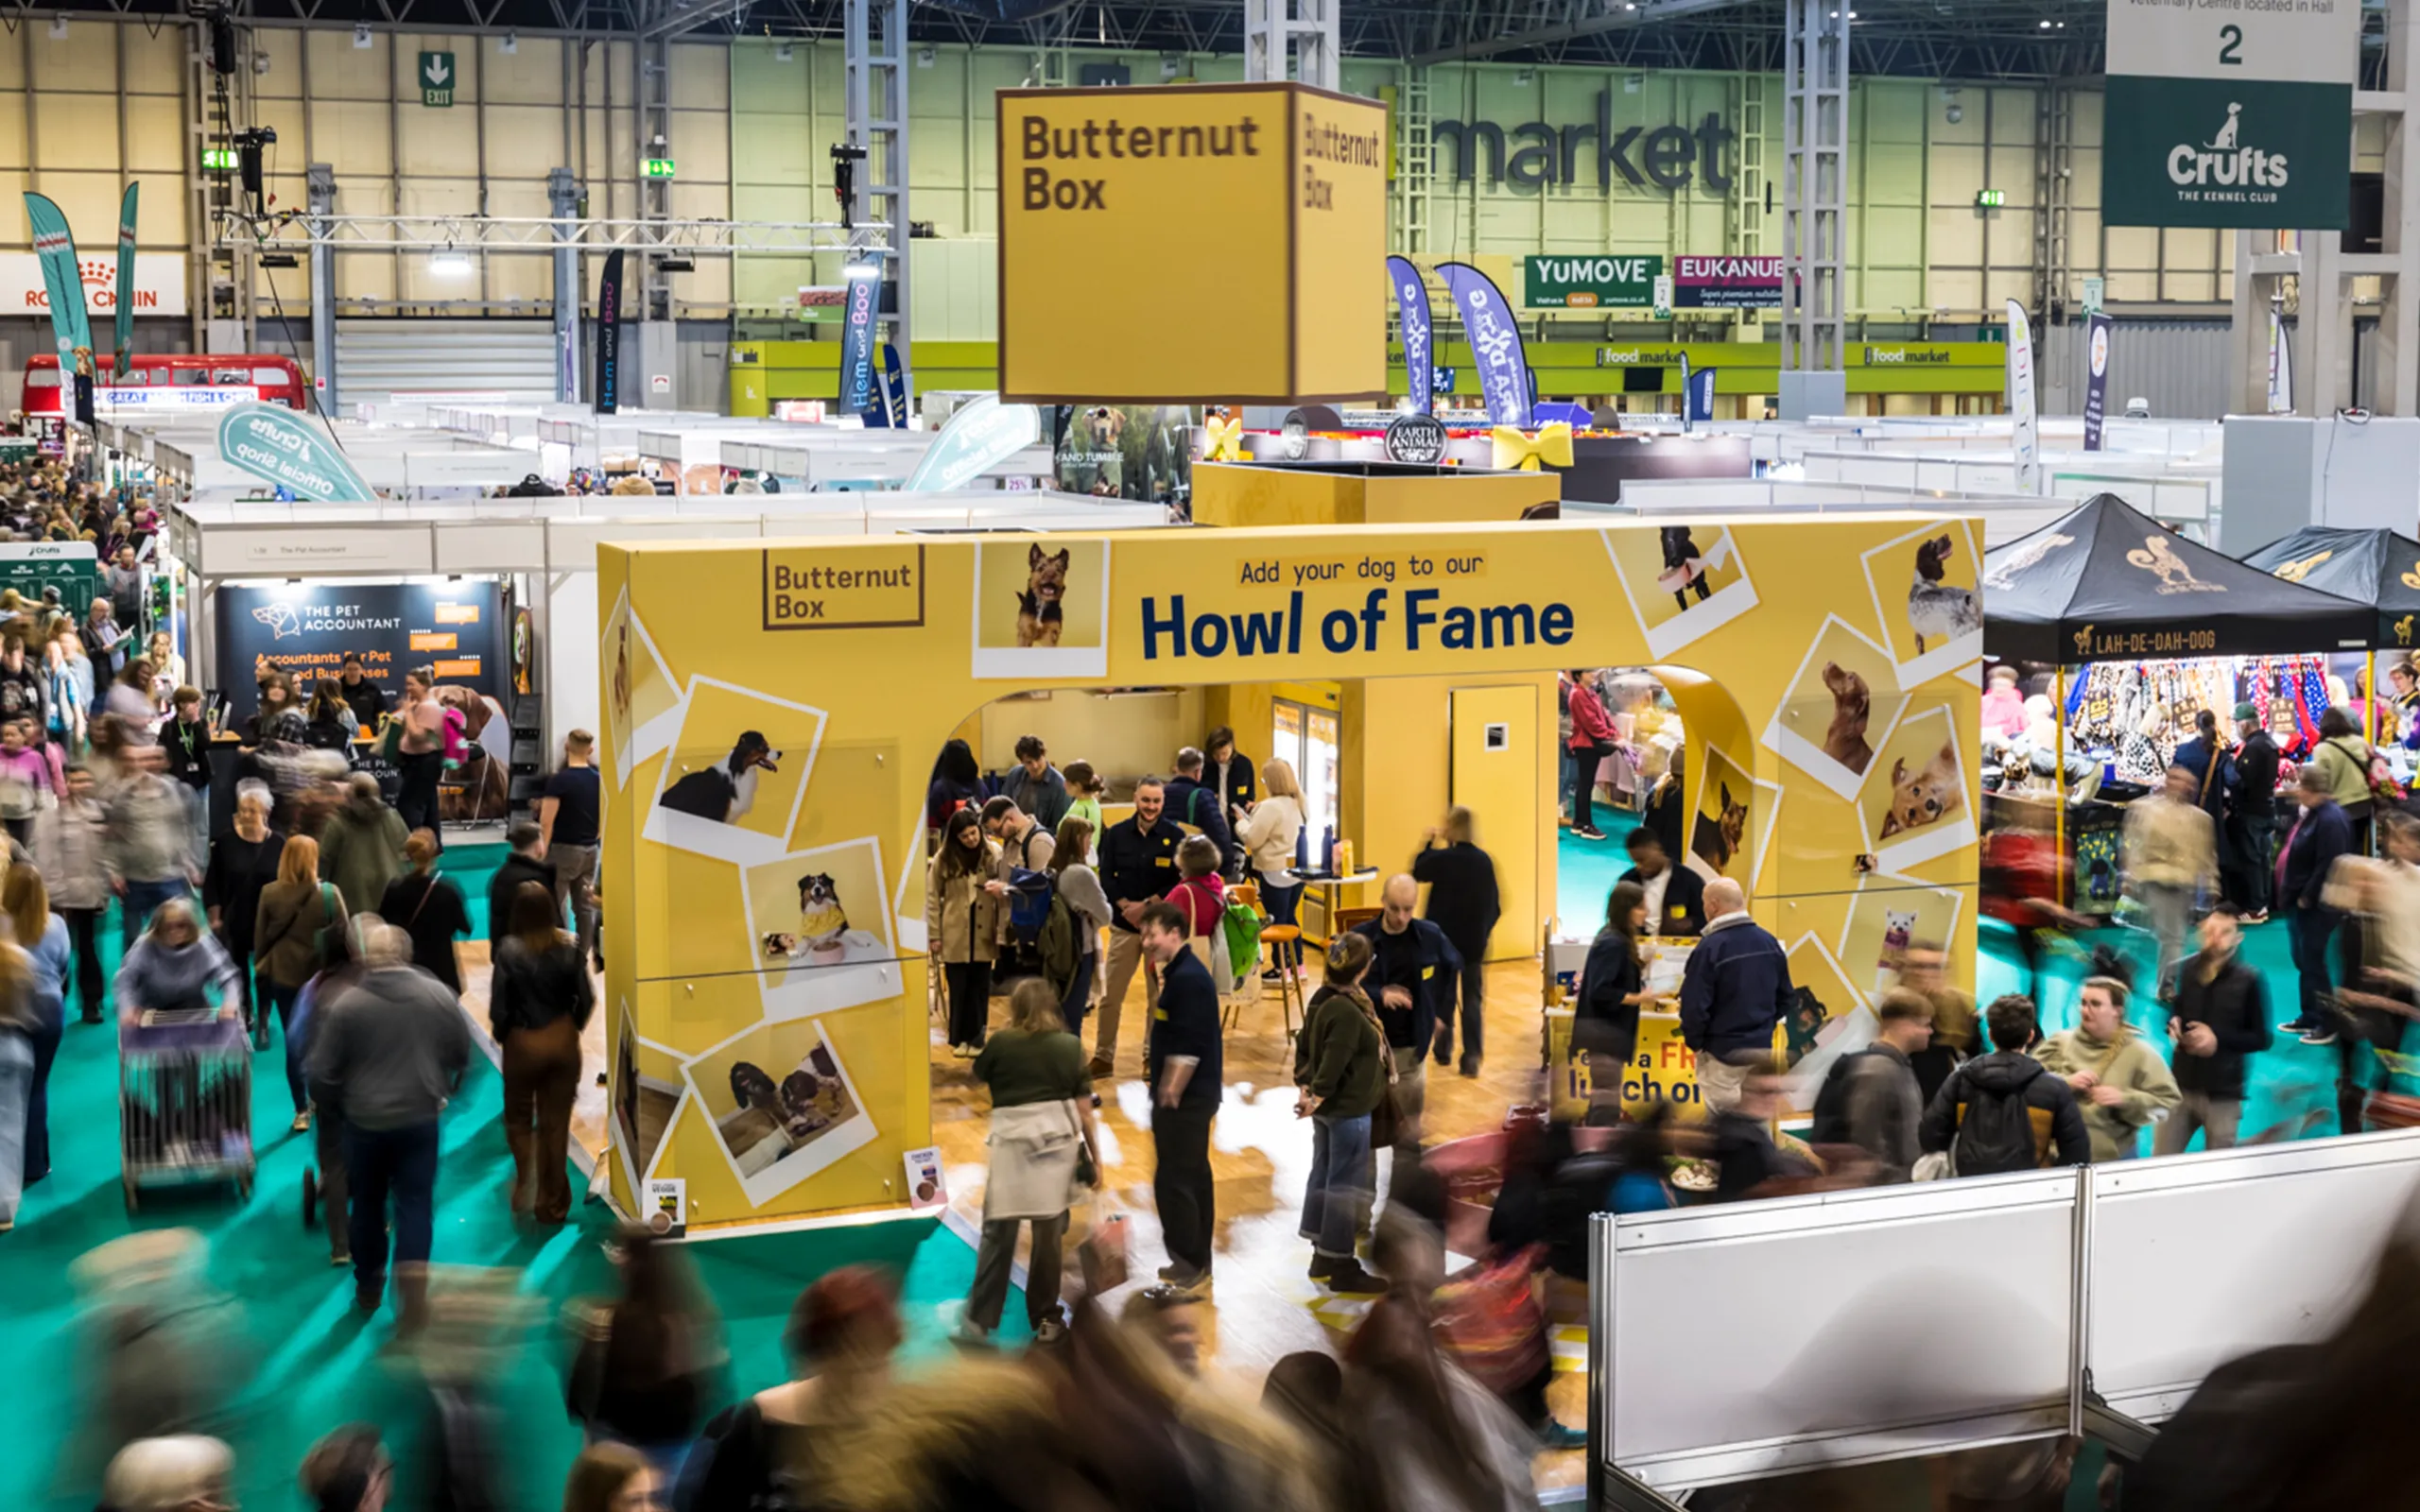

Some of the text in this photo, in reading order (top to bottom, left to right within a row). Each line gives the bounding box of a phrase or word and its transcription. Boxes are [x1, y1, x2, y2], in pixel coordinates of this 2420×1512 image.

[2197, 0, 2242, 9] Centre
[2244, 0, 2293, 12] located
[2297, 0, 2308, 12] in
[2312, 0, 2334, 13] Hall
[2219, 24, 2242, 65] 2
[426, 89, 450, 104] EXIT
[1022, 115, 1260, 161] Butternut
[1304, 112, 1379, 168] Butternut
[1429, 89, 1733, 190] market
[2167, 144, 2289, 187] Crufts
[1023, 166, 1107, 212] Box
[1305, 163, 1334, 212] Box
[2177, 191, 2278, 202] THE KENNEL CLUB
[93, 291, 157, 307] CIN
[856, 328, 866, 358] and
[852, 361, 868, 407] Hem
[1391, 437, 1442, 448] ANIMAL
[1396, 426, 1437, 438] EARTH
[774, 564, 911, 591] Butternut
[1240, 554, 1484, 587] Add your dog to our
[303, 605, 361, 617] THE PET
[775, 593, 824, 619] Box
[303, 617, 402, 631] ACCOUNTANT
[1141, 587, 1575, 660] Howl of Fame
[2096, 629, 2216, 655] LAH-DE-DAH-DOG
[370, 651, 392, 662] Pet
[1638, 1052, 1651, 1069] a
[1568, 1070, 1663, 1103] luch
